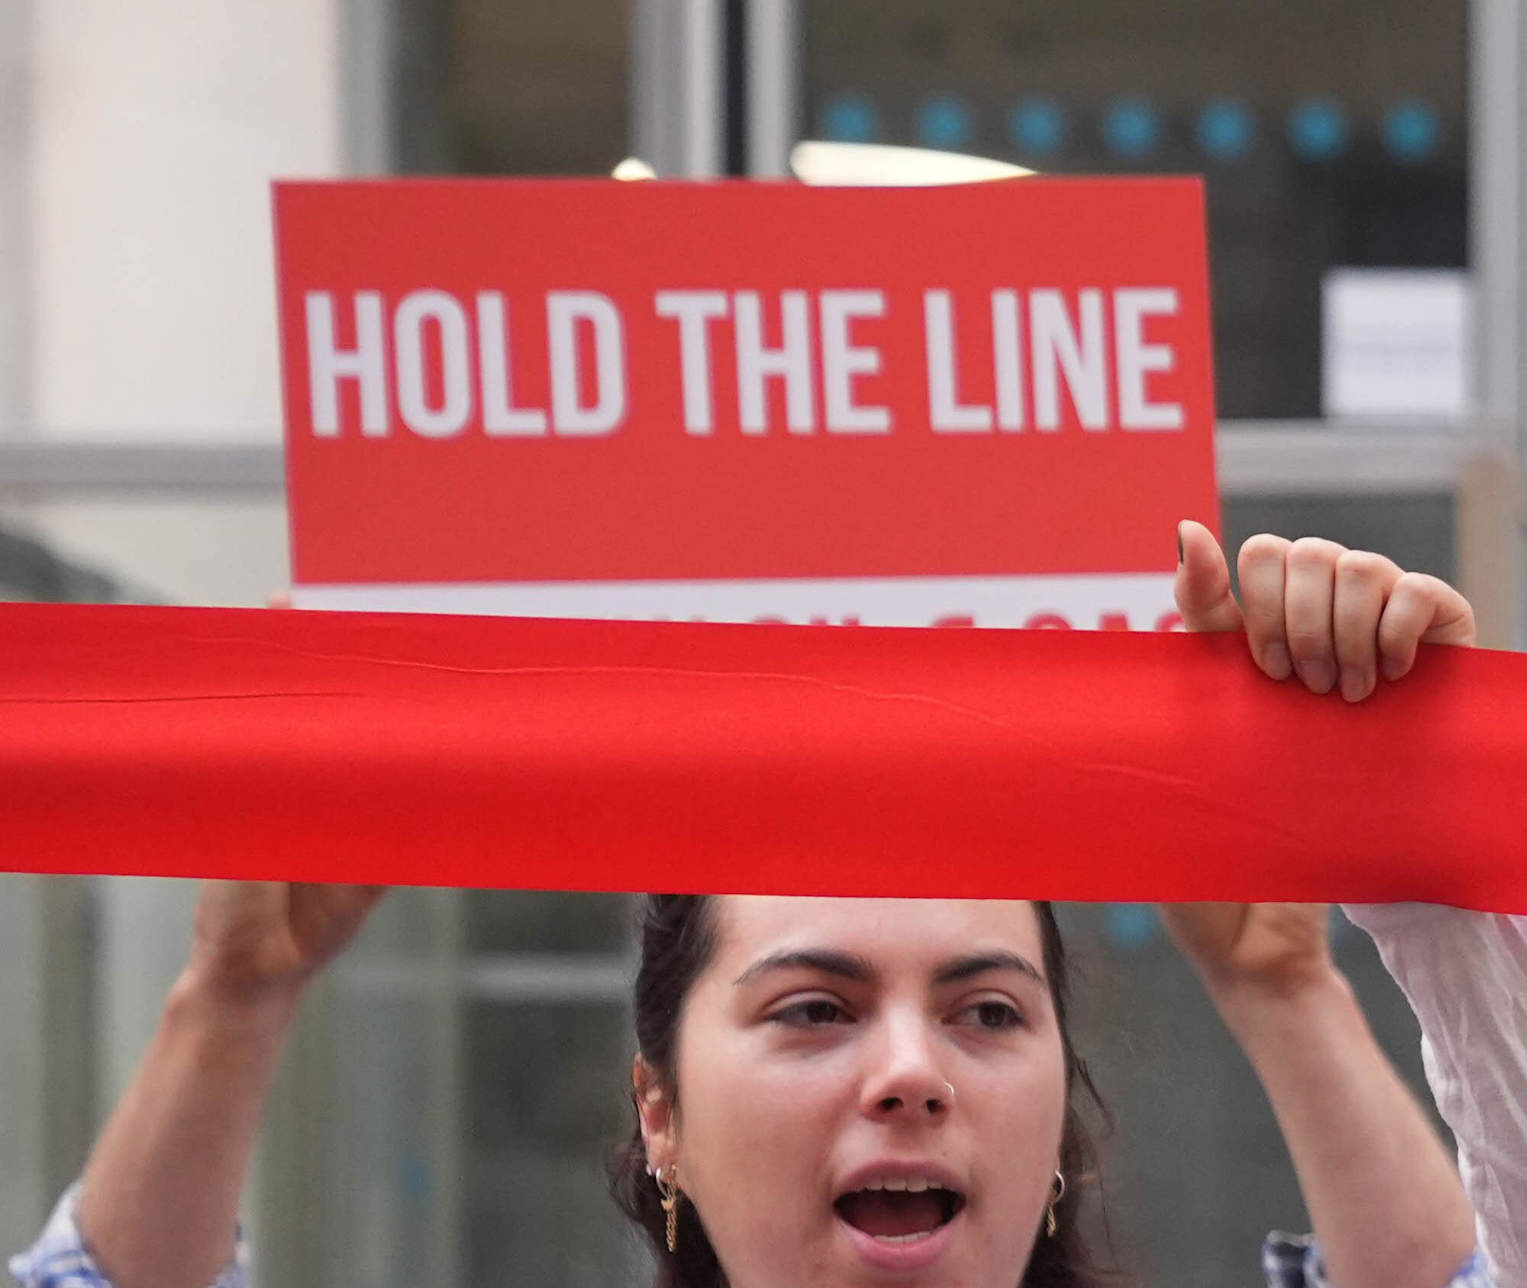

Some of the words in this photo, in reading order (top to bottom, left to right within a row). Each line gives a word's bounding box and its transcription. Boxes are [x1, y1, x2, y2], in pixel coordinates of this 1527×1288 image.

[305, 289, 628, 438] HOLD
[655, 290, 892, 436] THE
[925, 288, 1184, 432] LINE
